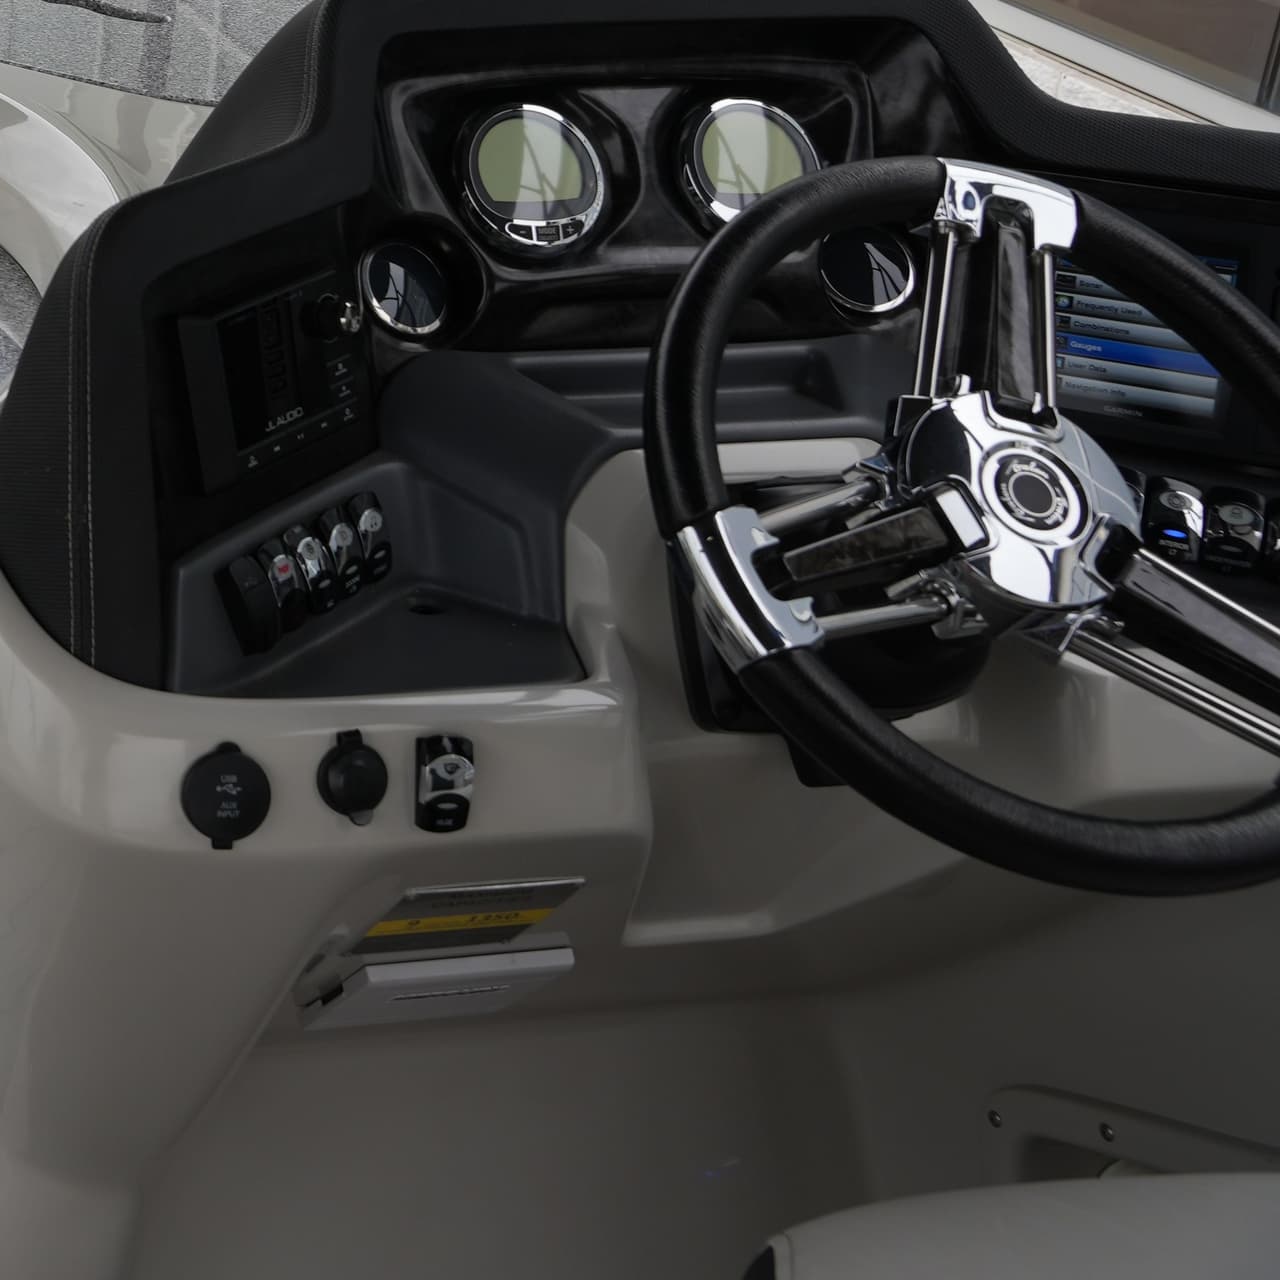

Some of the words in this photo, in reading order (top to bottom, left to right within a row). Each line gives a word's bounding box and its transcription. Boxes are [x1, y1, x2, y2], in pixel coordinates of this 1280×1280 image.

[1077, 300, 1118, 313] Frequently
[1121, 308, 1142, 316] Used
[1073, 321, 1130, 335] Combinations
[1070, 341, 1102, 352] Gauges
[1088, 364, 1107, 373] Data
[276, 406, 304, 426] AUDIO
[220, 775, 238, 783] USB
